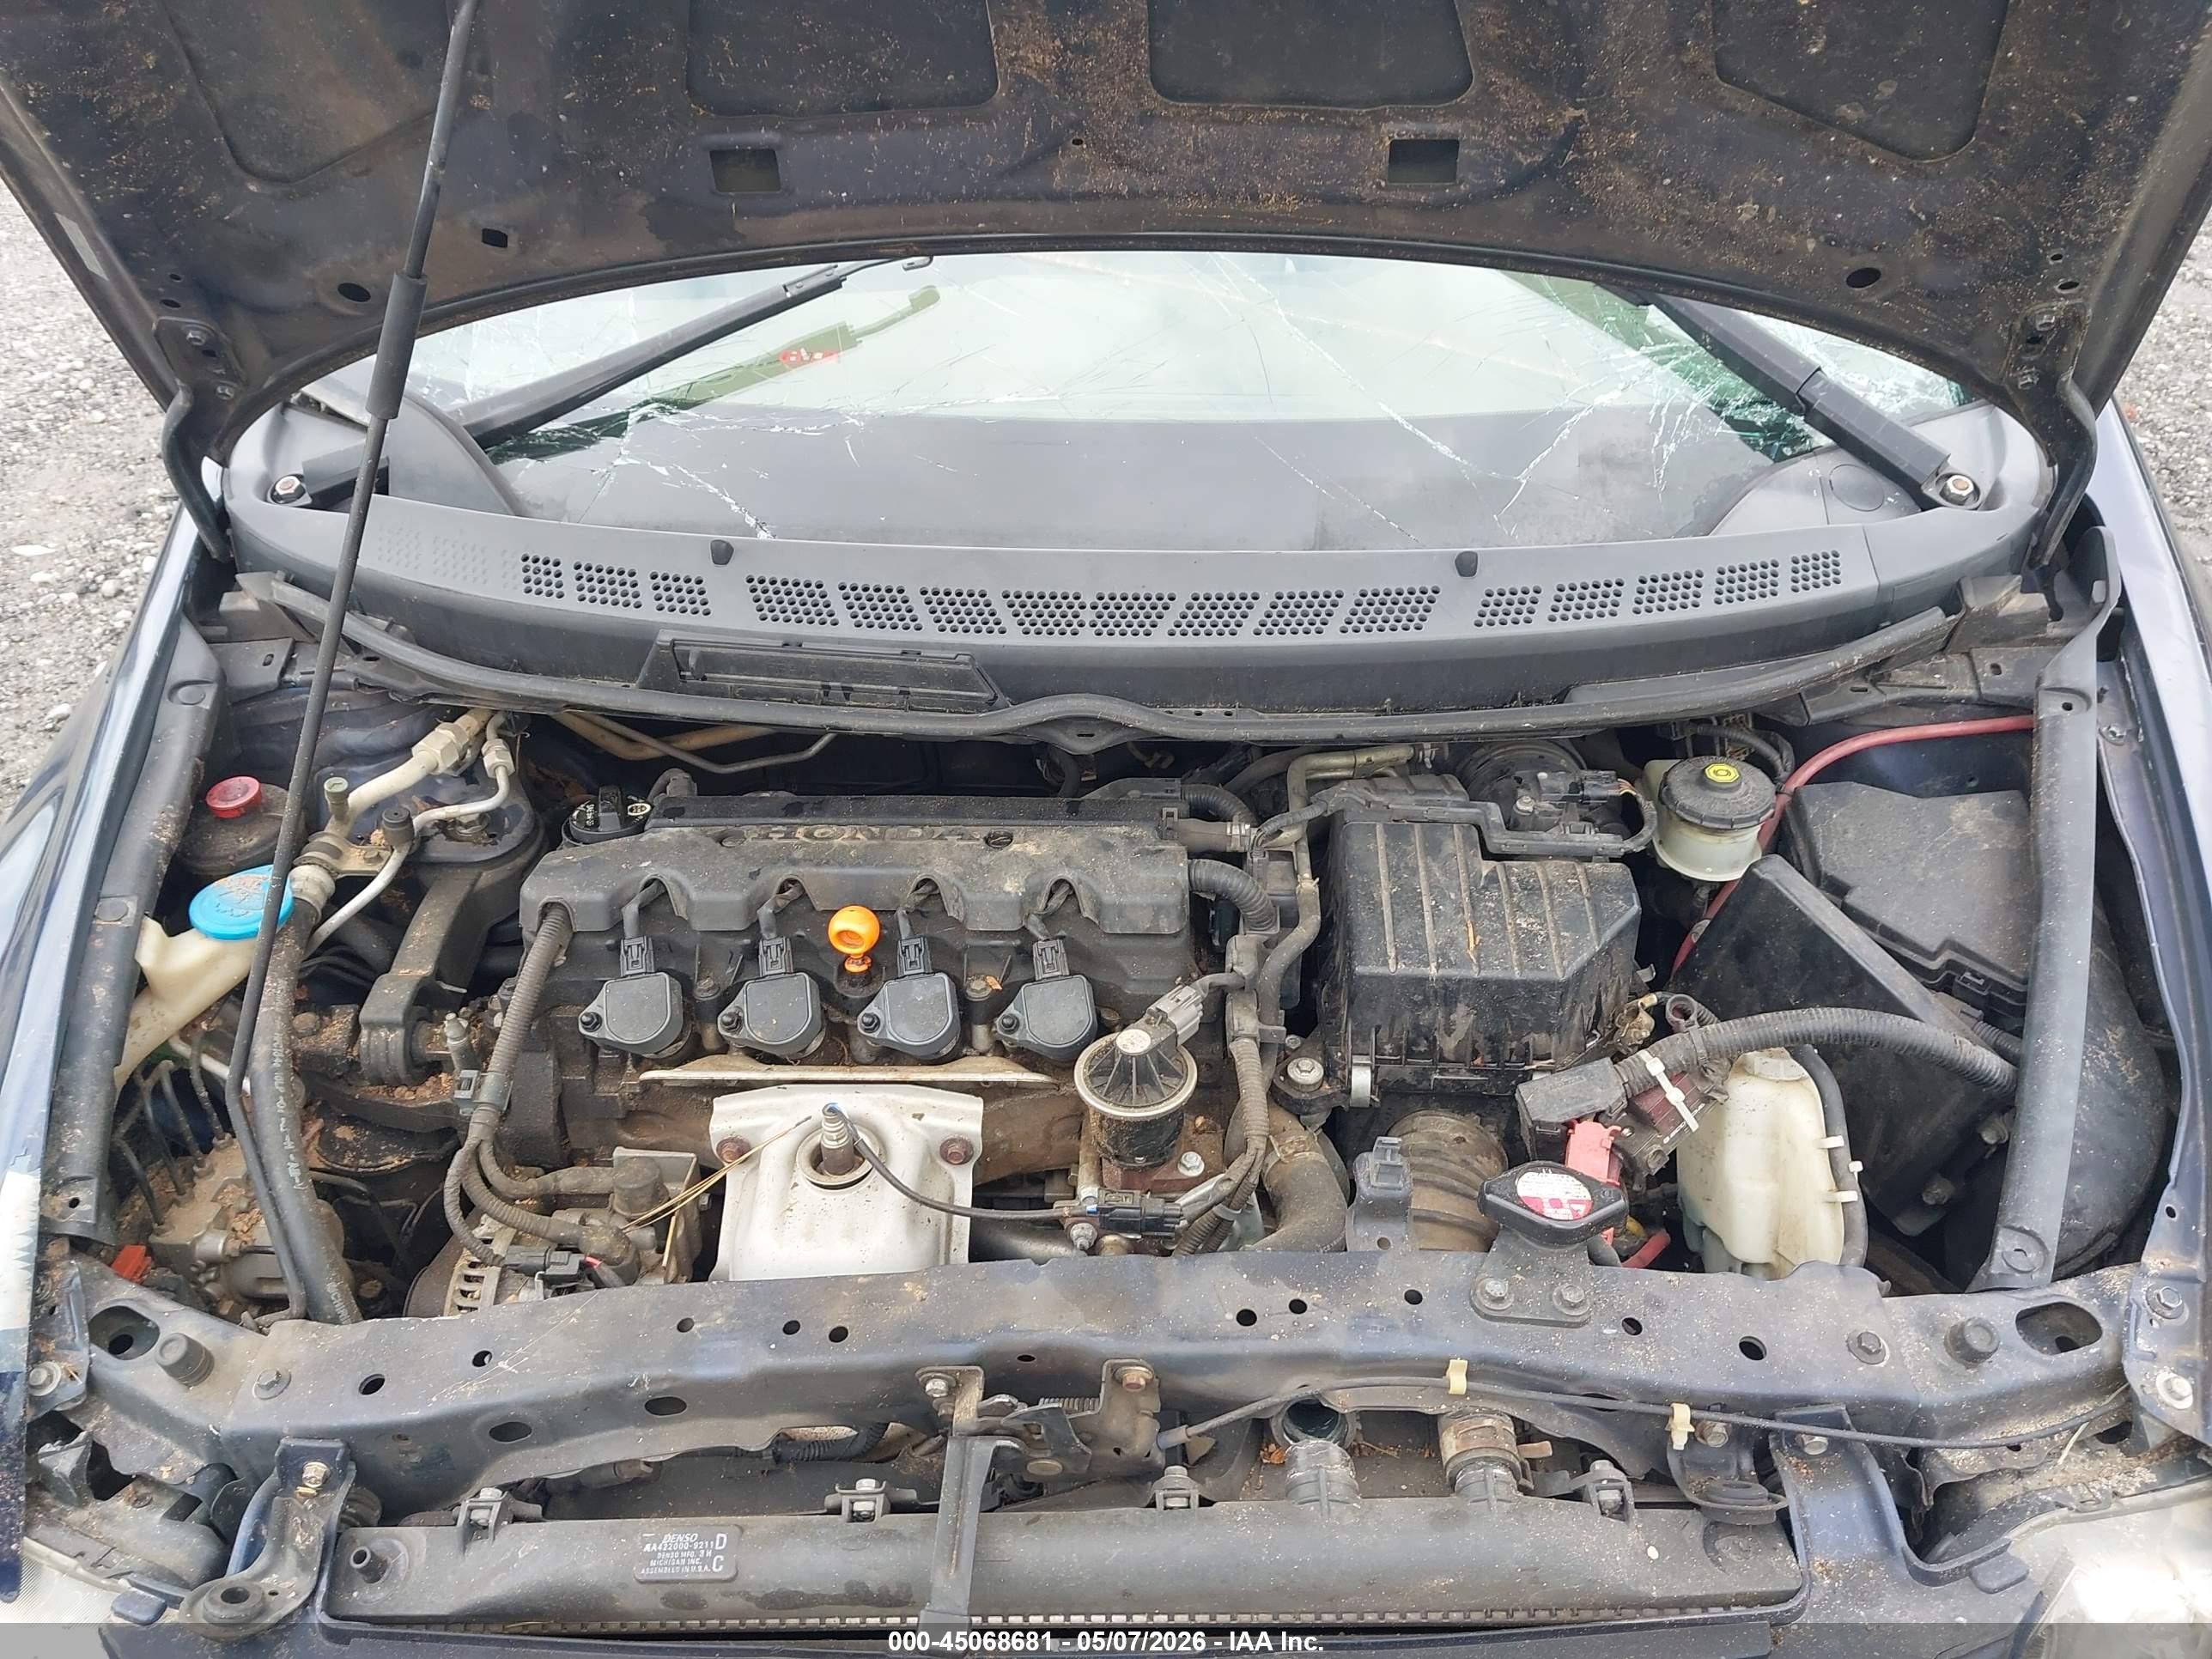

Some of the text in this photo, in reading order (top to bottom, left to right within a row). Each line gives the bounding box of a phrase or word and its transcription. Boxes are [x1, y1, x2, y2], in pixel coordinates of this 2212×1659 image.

[749, 823, 981, 842] HONDA
[662, 1533, 727, 1550] DENSO D
[649, 1558, 686, 1567] MICHIGAN
[712, 1554, 725, 1572] C
